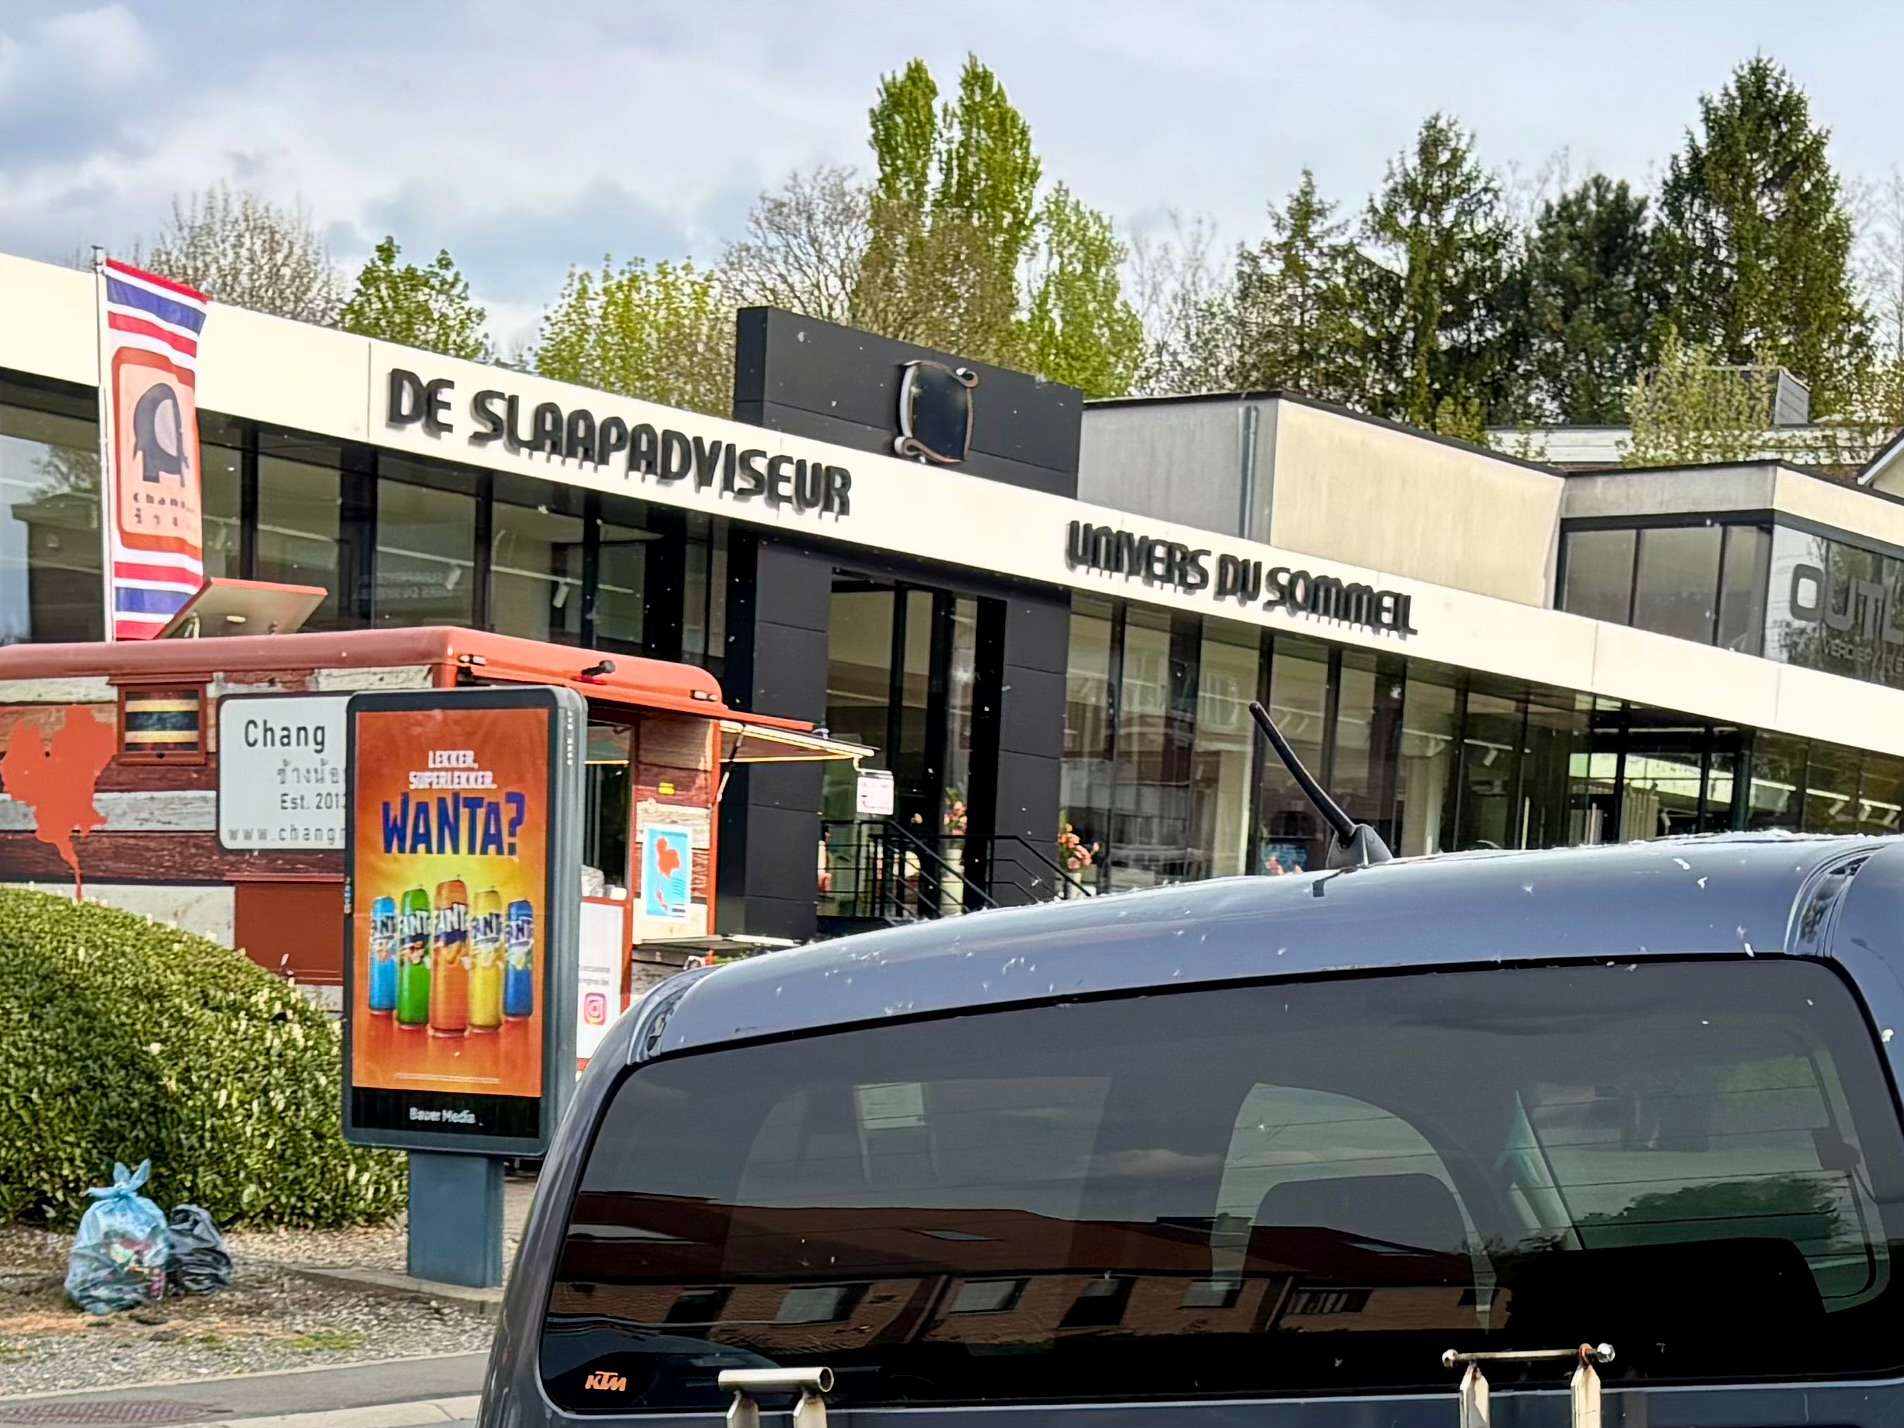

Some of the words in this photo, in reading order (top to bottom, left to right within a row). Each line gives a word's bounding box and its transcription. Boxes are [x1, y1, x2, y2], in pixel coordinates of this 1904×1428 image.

[386, 368, 455, 437] DE
[469, 390, 852, 520] SLAAPADVISEUR
[1065, 520, 1211, 594] UNIVERS
[1214, 554, 1262, 605] DU
[1263, 567, 1418, 638] SOMMEIL
[244, 719, 326, 754] Chang
[428, 750, 479, 769] LEKKER,
[408, 771, 498, 789] SUPERLEKKER.
[280, 793, 311, 810] Est.
[382, 791, 526, 856] WANTA?
[585, 1371, 627, 1392] KTM
